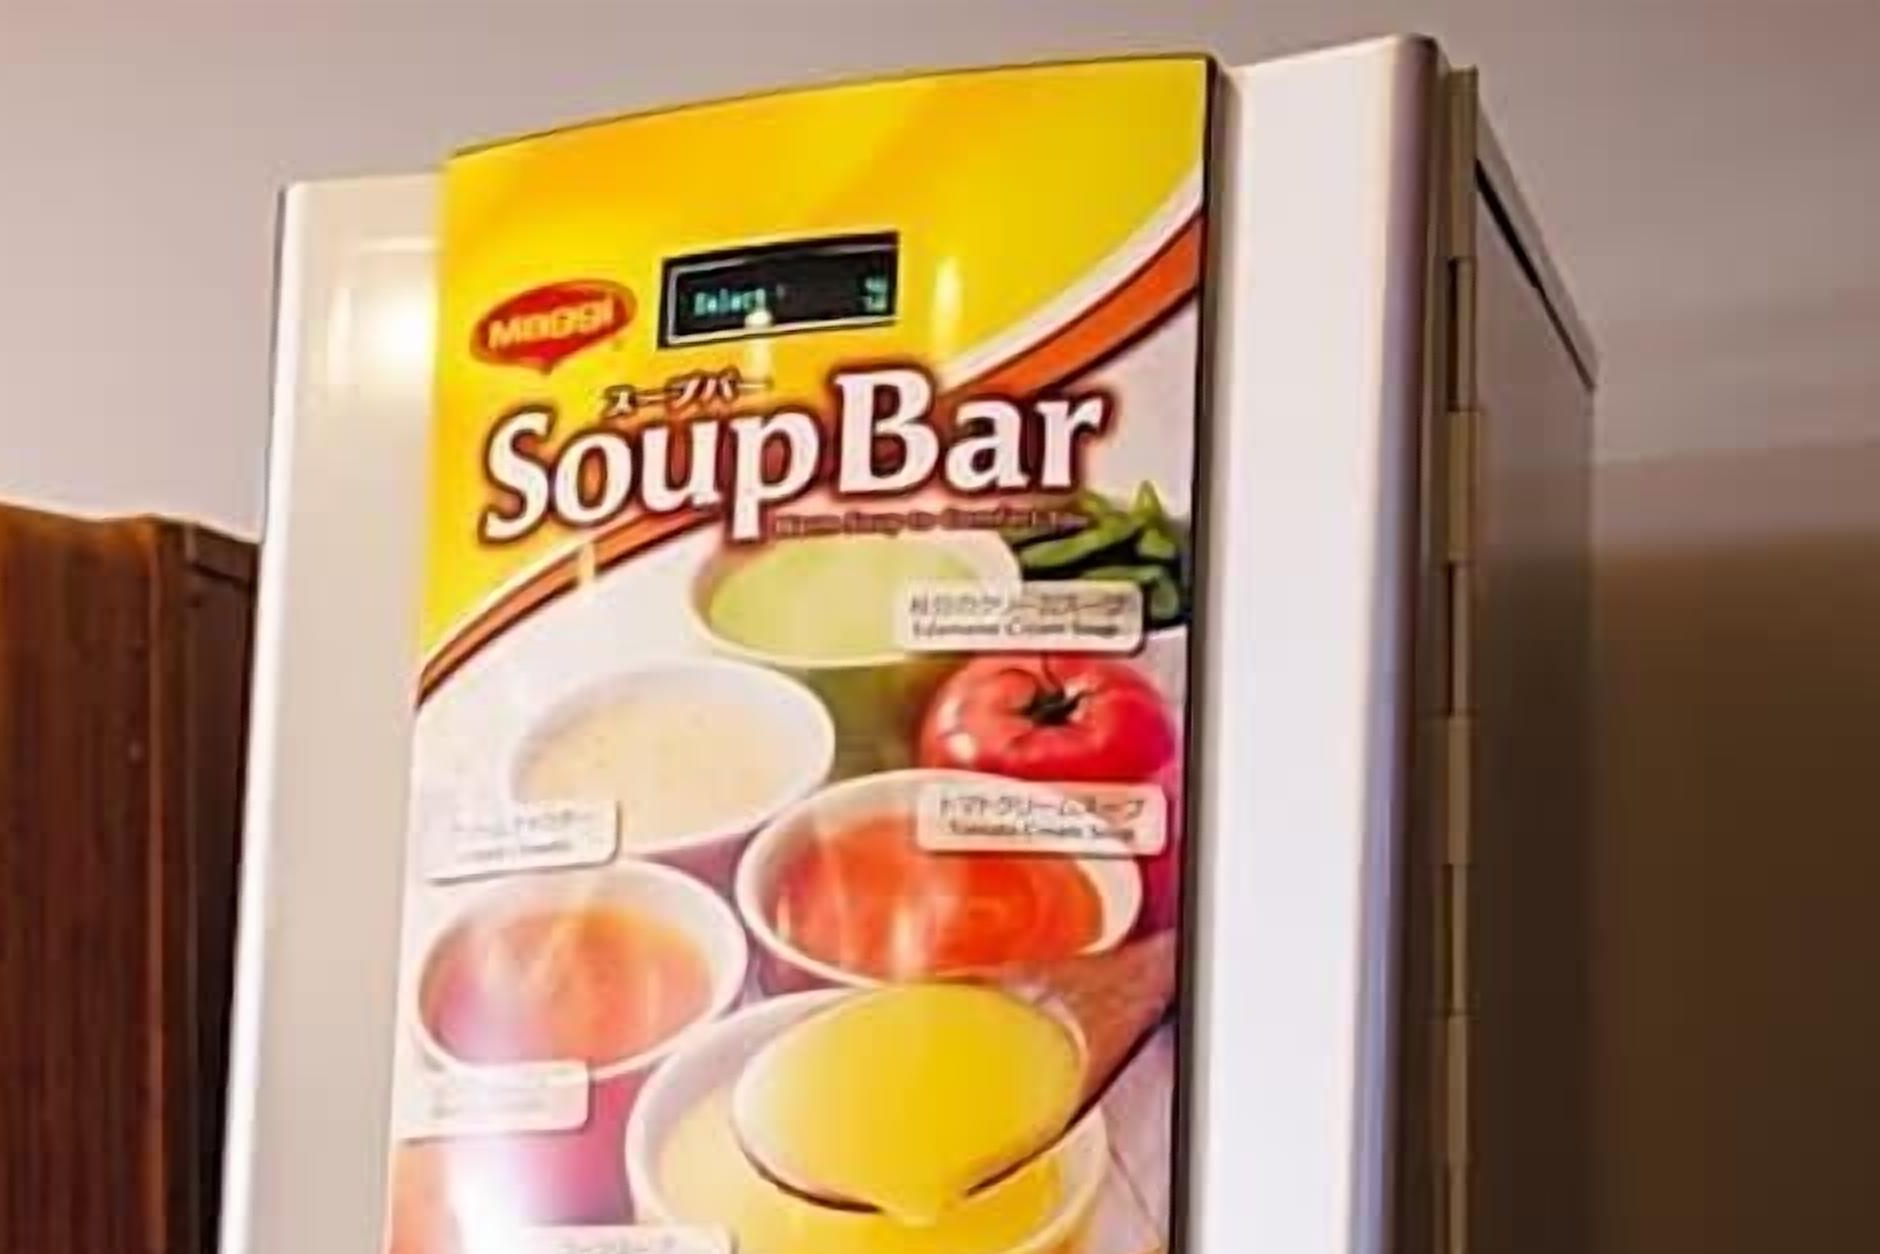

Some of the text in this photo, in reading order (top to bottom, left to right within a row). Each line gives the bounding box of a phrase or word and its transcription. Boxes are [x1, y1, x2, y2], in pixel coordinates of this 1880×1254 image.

[610, 371, 768, 414] スープバー
